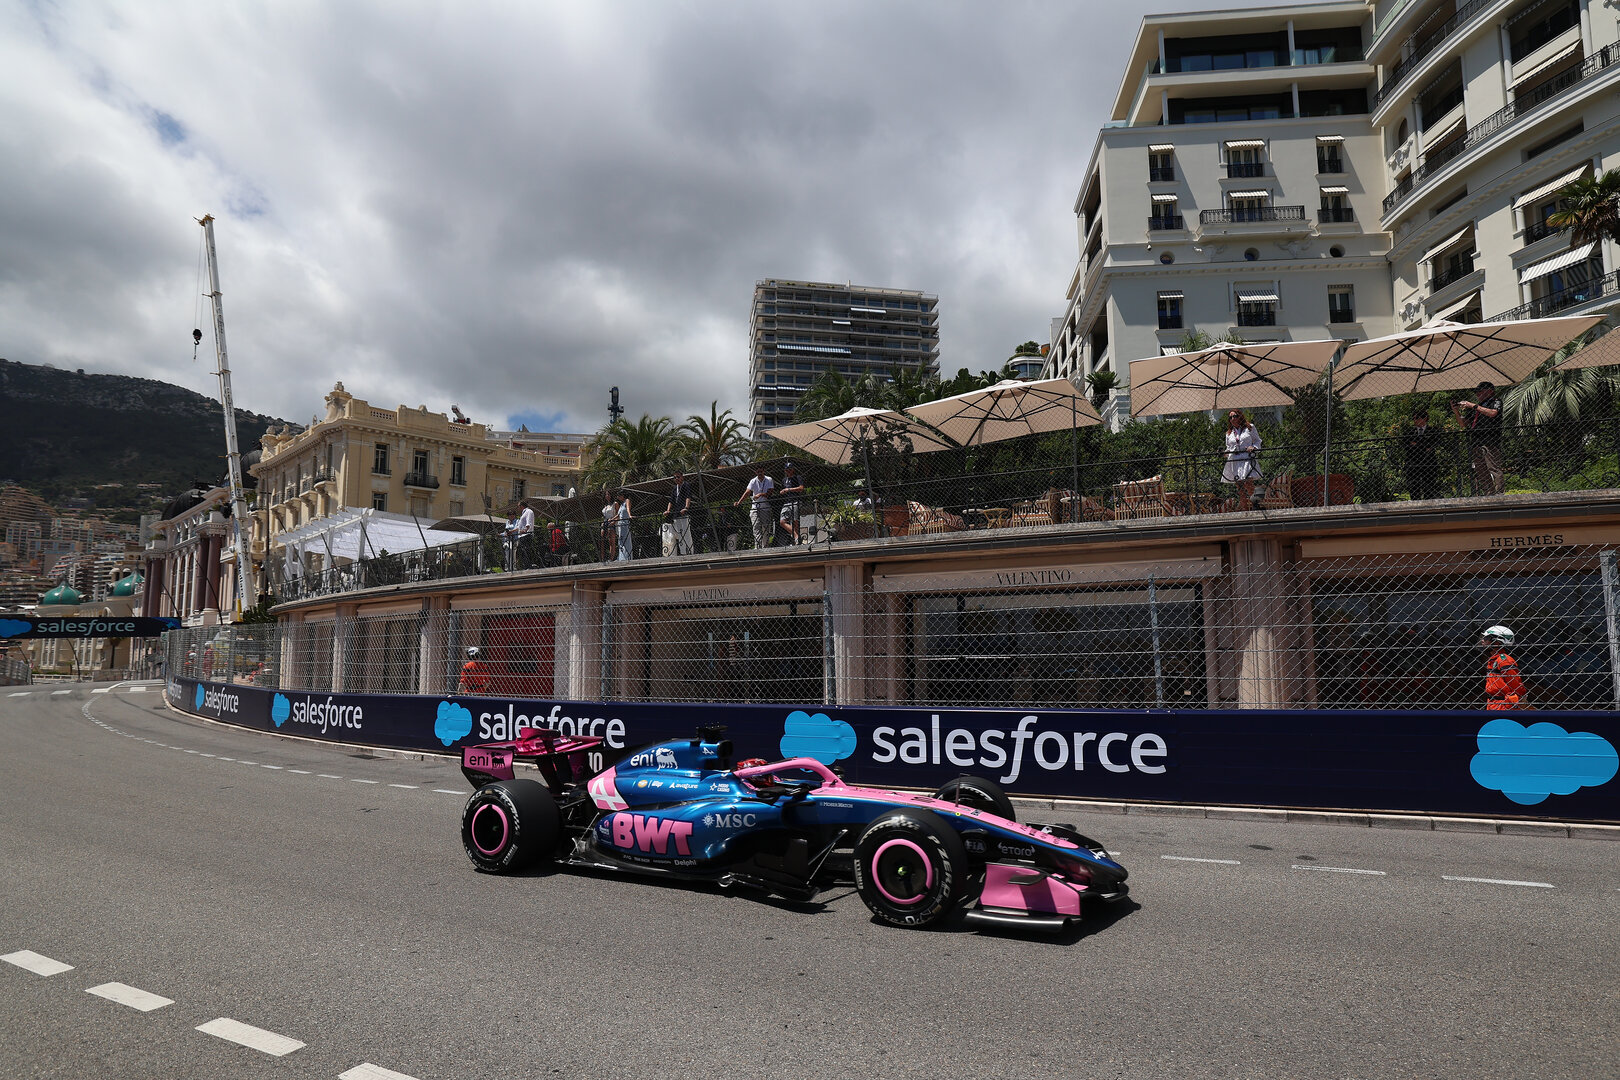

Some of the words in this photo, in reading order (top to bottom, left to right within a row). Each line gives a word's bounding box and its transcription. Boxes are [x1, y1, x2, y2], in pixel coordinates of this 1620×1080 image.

[996, 568, 1071, 585] VALENTINO
[682, 587, 730, 600] VALENTINO
[37, 619, 135, 636] salesforce
[204, 686, 239, 716] salesforce
[292, 695, 363, 734] salesforce
[630, 749, 655, 767] eni
[872, 715, 1168, 784] salesforce
[469, 752, 489, 766] eni
[588, 752, 603, 773] 10
[715, 813, 756, 828] MSC
[612, 812, 693, 856] BWT
[674, 859, 697, 867] Delphi
